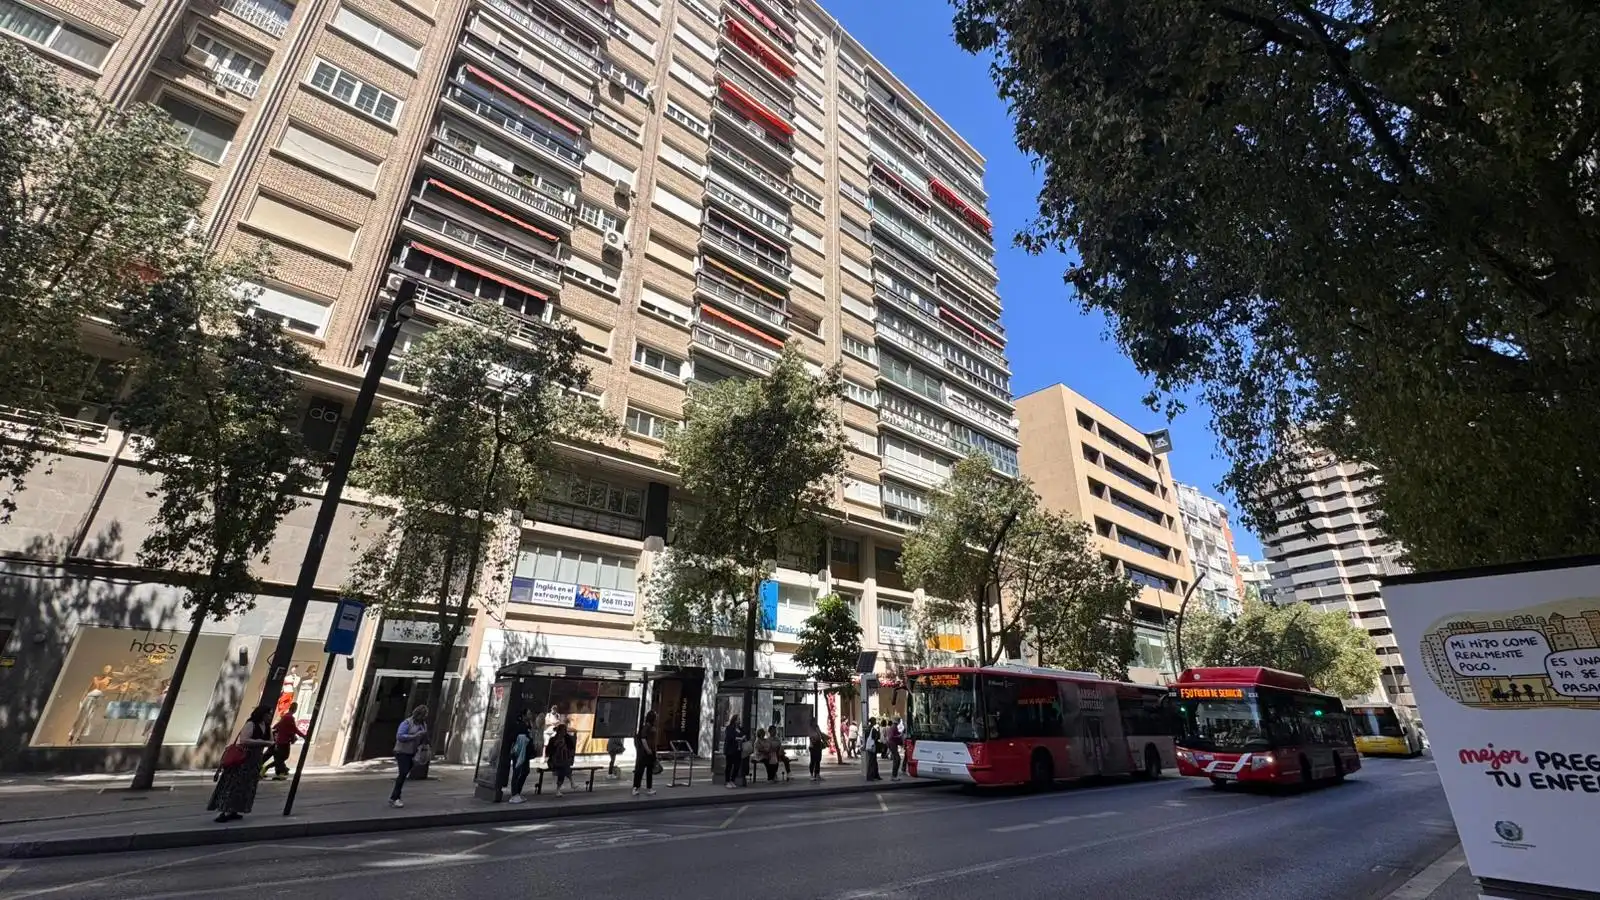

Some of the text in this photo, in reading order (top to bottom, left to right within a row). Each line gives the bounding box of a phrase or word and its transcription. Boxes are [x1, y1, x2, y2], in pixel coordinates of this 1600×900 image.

[536, 582, 556, 591] Inglés
[534, 592, 573, 601] extranjero
[130, 638, 177, 654] hoss
[1503, 636, 1538, 647] COME
[1454, 650, 1524, 660] REALMENTE
[412, 656, 431, 665] 21A
[1550, 657, 1568, 667] ES
[1459, 662, 1497, 672] POCO.
[1556, 670, 1574, 679] YA
[1458, 742, 1600, 772] mejor PREG
[1485, 770, 1600, 793] TU ENFE
